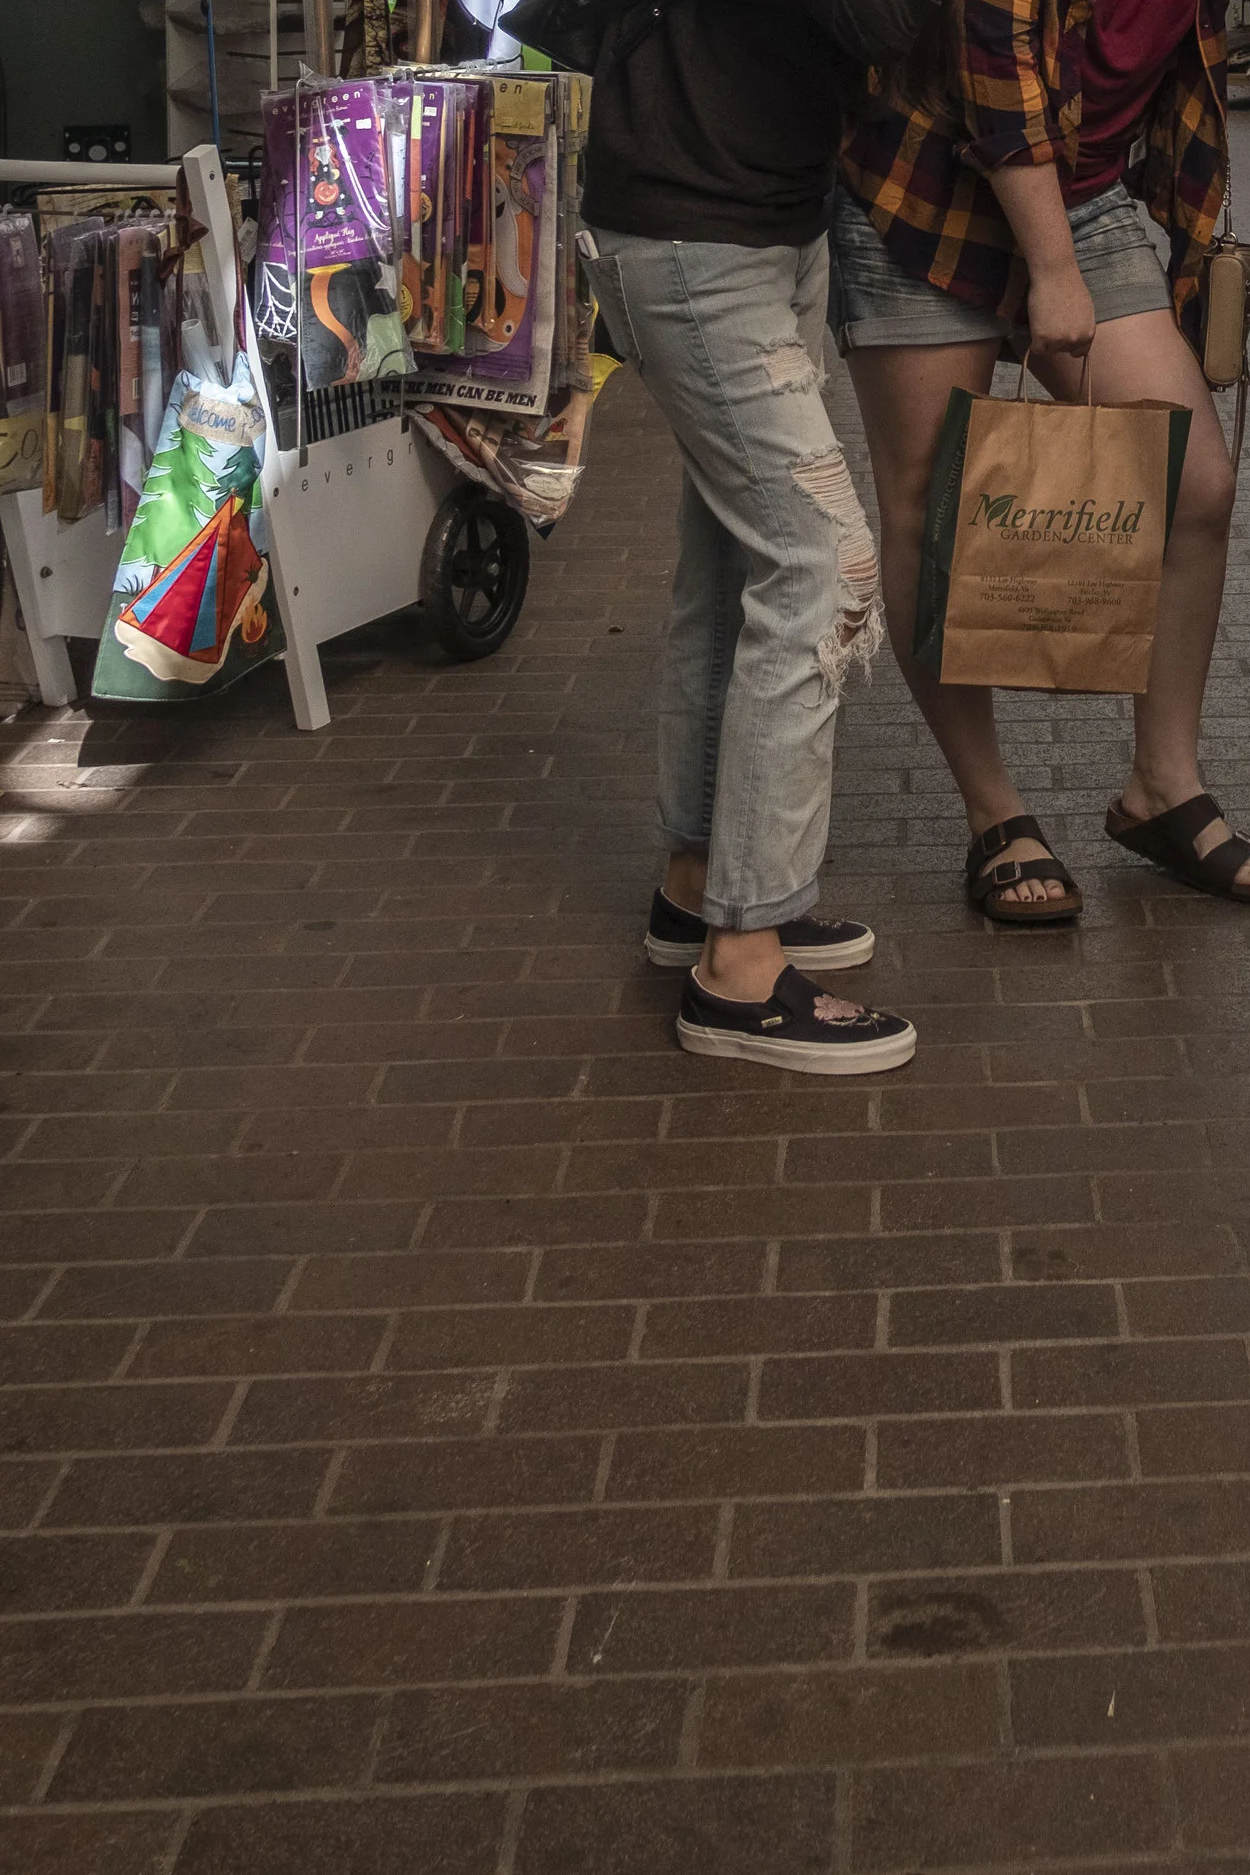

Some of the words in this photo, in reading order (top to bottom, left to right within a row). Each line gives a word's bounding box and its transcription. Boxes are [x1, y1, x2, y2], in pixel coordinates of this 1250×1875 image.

[381, 380, 426, 395] WHERE
[424, 382, 456, 398] MEN
[457, 384, 485, 400] CAN
[485, 389, 505, 402] BE
[505, 391, 538, 408] MEN
[968, 493, 1145, 545] Merrifield
[1000, 528, 1064, 543] GARDEN
[1077, 533, 1134, 546] CENTER
[980, 593, 1035, 603] 703-560-6222
